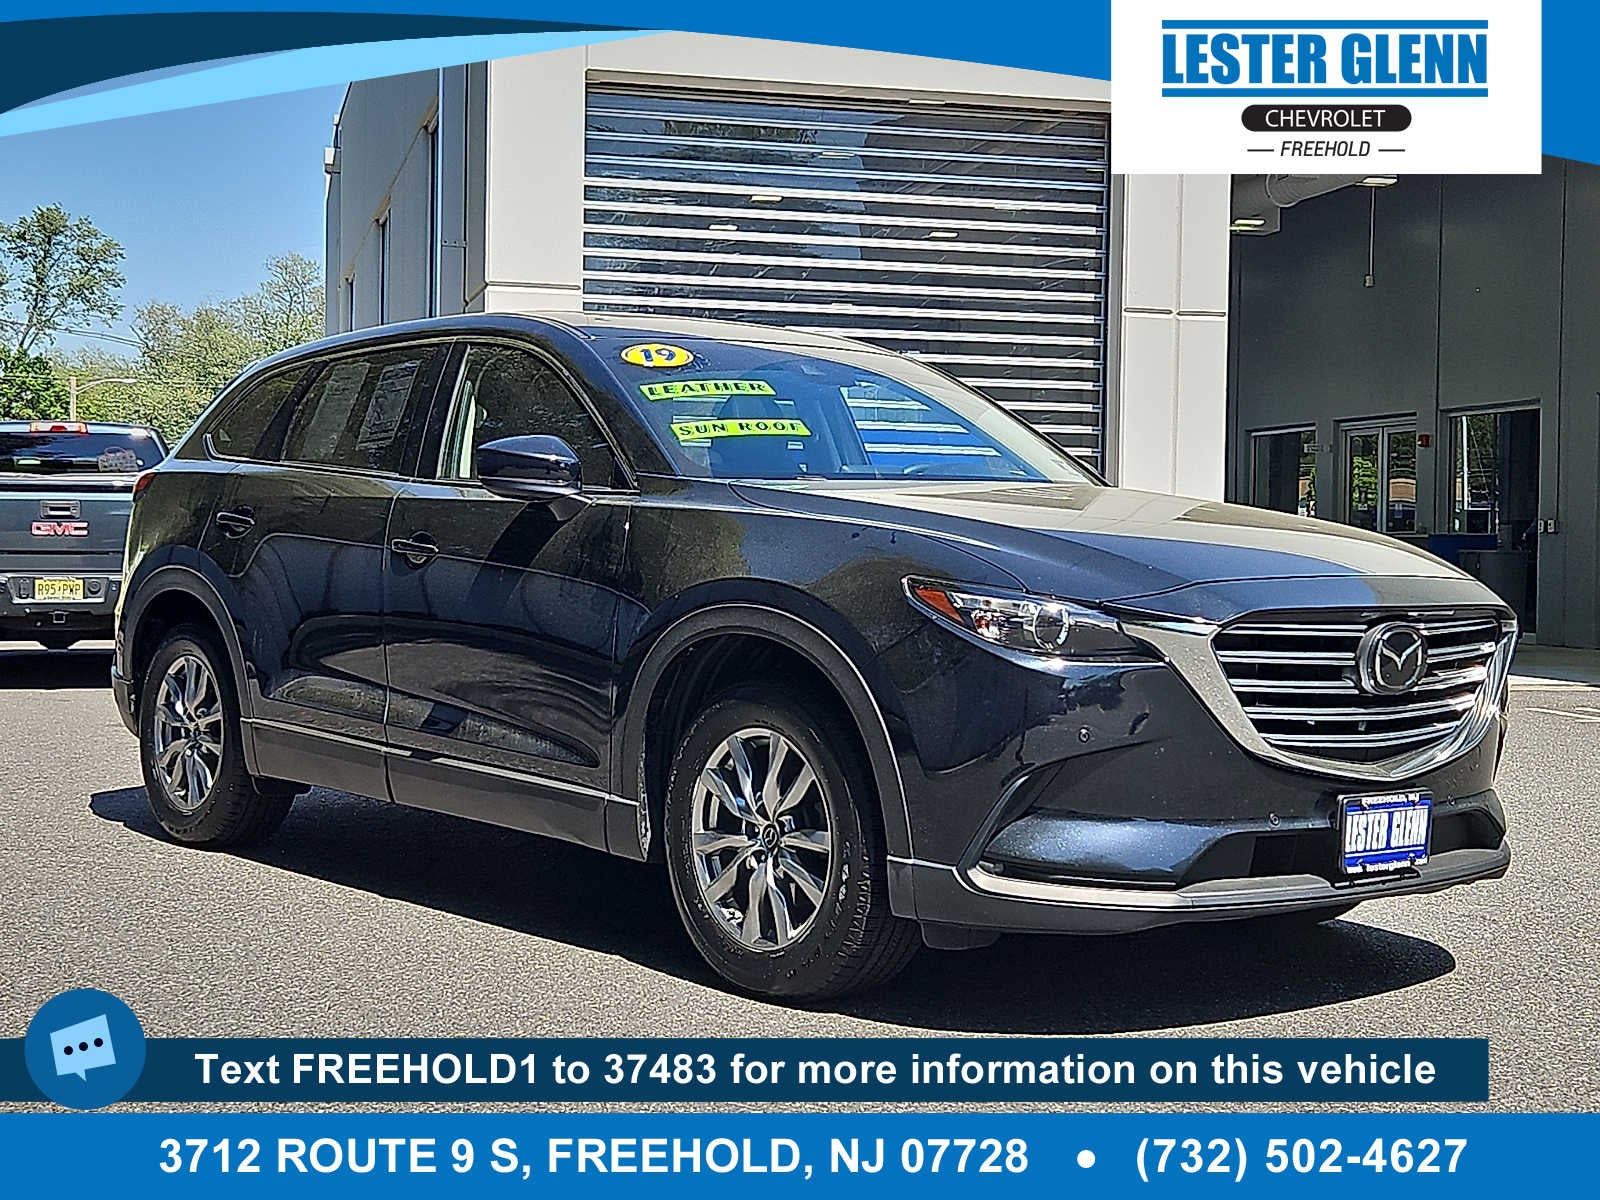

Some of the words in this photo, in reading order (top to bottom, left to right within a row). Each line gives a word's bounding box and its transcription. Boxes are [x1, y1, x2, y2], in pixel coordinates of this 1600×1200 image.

[641, 348, 676, 361] 19
[648, 383, 766, 396] LEATHER
[679, 423, 726, 436] SUN
[739, 422, 802, 432] ROOF
[31, 522, 88, 536] GMC
[1345, 812, 1389, 853] LESTER
[1390, 809, 1429, 848] GLENN
